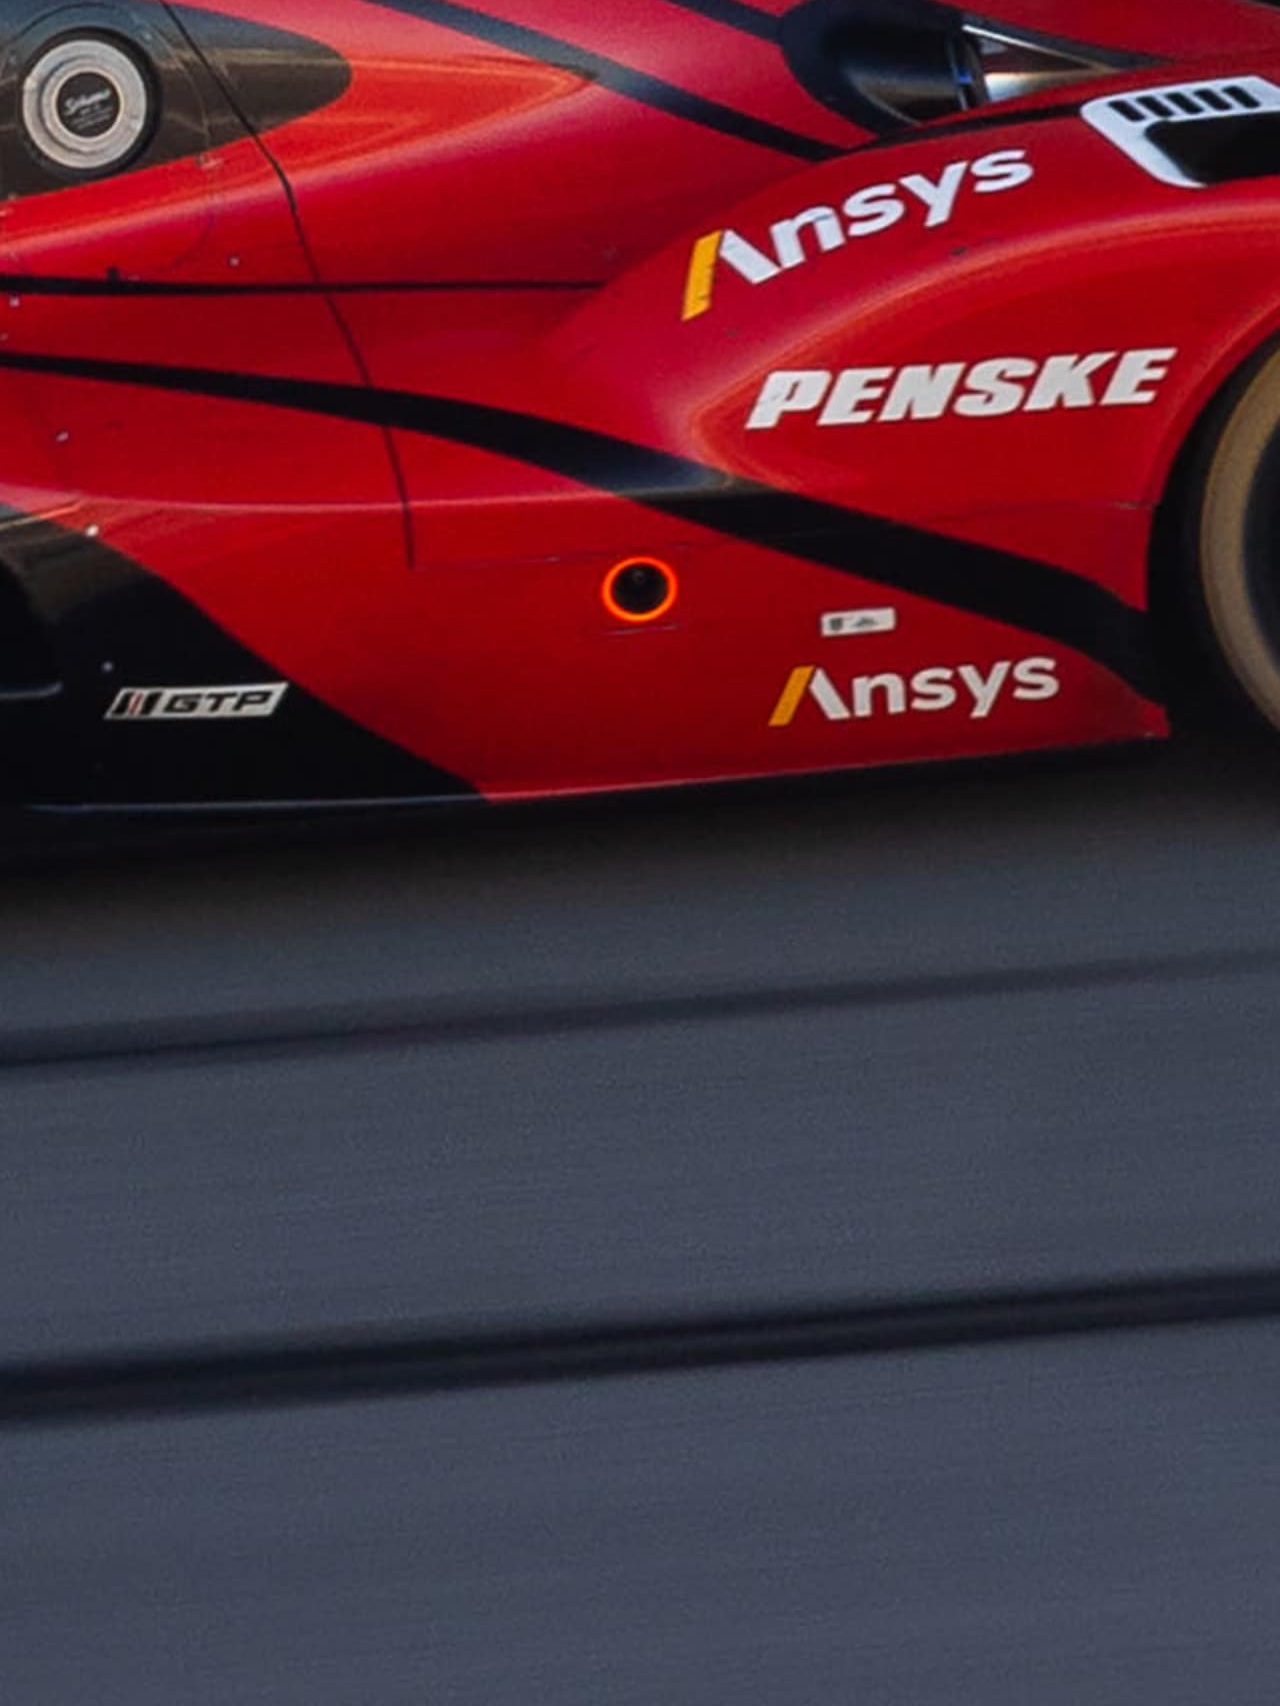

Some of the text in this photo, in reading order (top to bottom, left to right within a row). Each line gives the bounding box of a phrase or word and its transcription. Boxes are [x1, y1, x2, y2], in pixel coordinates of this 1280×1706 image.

[681, 148, 1034, 322] Ansys
[745, 347, 1177, 430] PENSKE
[163, 690, 272, 714] GTP
[768, 655, 1060, 727] Ansys
